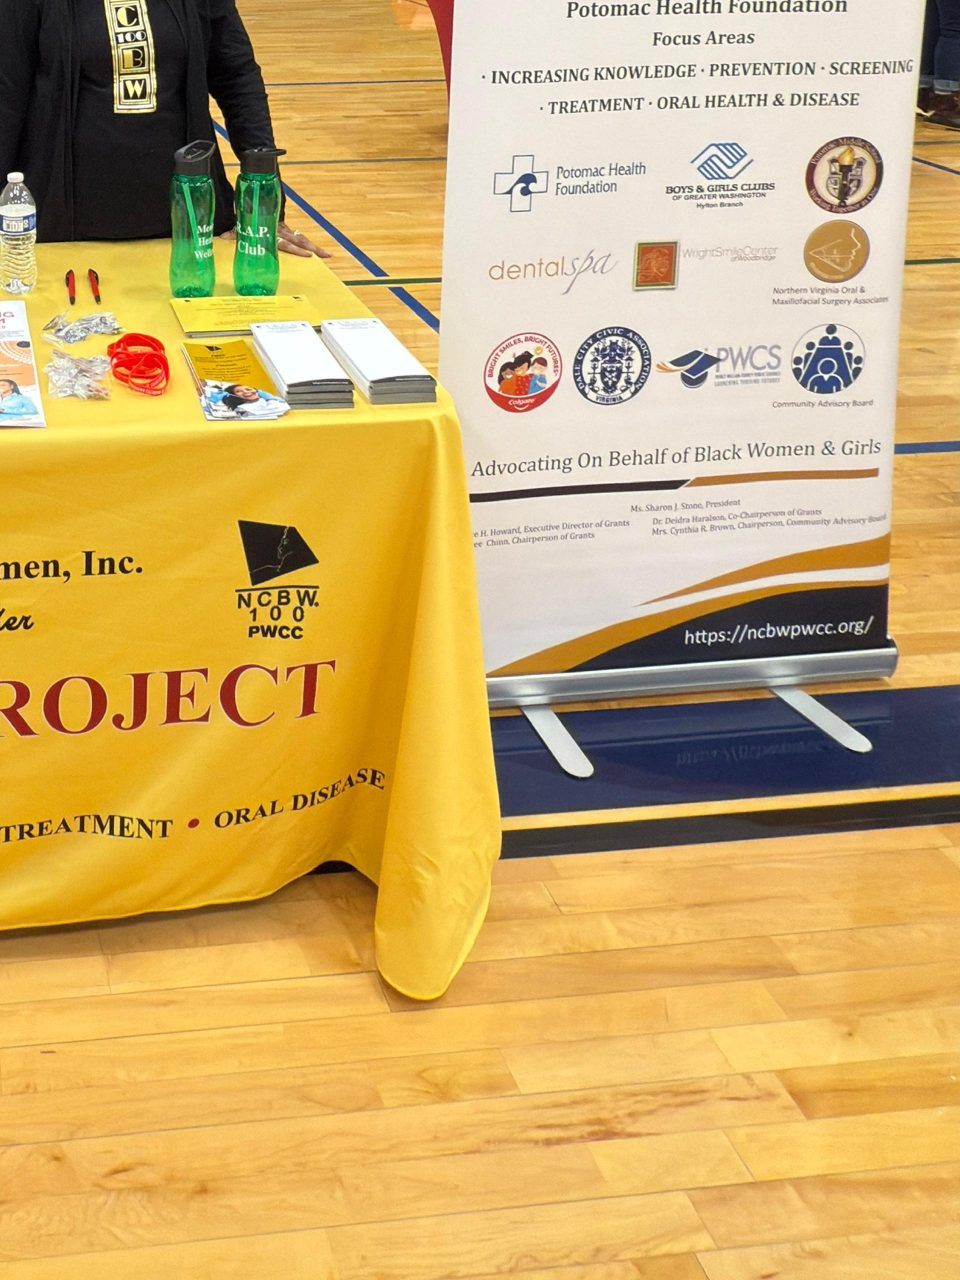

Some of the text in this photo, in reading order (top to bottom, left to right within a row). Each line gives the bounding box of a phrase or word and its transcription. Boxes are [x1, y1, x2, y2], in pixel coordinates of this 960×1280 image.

[566, 1, 651, 18] Potomac
[653, 30, 755, 46] Focus Areas
[491, 59, 914, 85] INCREASING KNOWLEDGE PREVENTION SCREENING
[548, 92, 860, 115] TREATMENT ORAL HEALTH & DISEASE
[556, 162, 647, 180] Potomac Health
[555, 180, 617, 196] Foundation
[665, 182, 776, 195] BOYS & GIRLS CLUBS
[683, 192, 767, 201] GREATER WASHINGTON
[238, 240, 266, 256] Club
[773, 285, 858, 295] Northern Virginia Oral
[822, 297, 851, 306] Surgery
[577, 338, 594, 360] CITY
[596, 328, 625, 339] CIVIC
[488, 352, 501, 378] BRIGHT
[500, 337, 524, 354] SMILES,
[524, 336, 547, 347] BRIGHT
[715, 344, 782, 373] PWCS
[772, 398, 874, 409] Community Advisory Board
[471, 438, 881, 477] Advocating On Behalf of Black Women & Girls
[645, 499, 741, 512] Sharon President
[524, 523, 560, 533] Executive
[562, 521, 593, 530] Director
[604, 519, 630, 528] Grants
[786, 518, 830, 527] Community
[512, 531, 595, 545] Chairperson Grants
[80, 550, 143, 576] Inc.
[248, 606, 304, 622] 100
[247, 625, 303, 640] PWCC
[684, 615, 874, 646] https://ncbwpwcc.org/
[213, 798, 285, 829] ORAL
[289, 766, 386, 814] DISEASE
